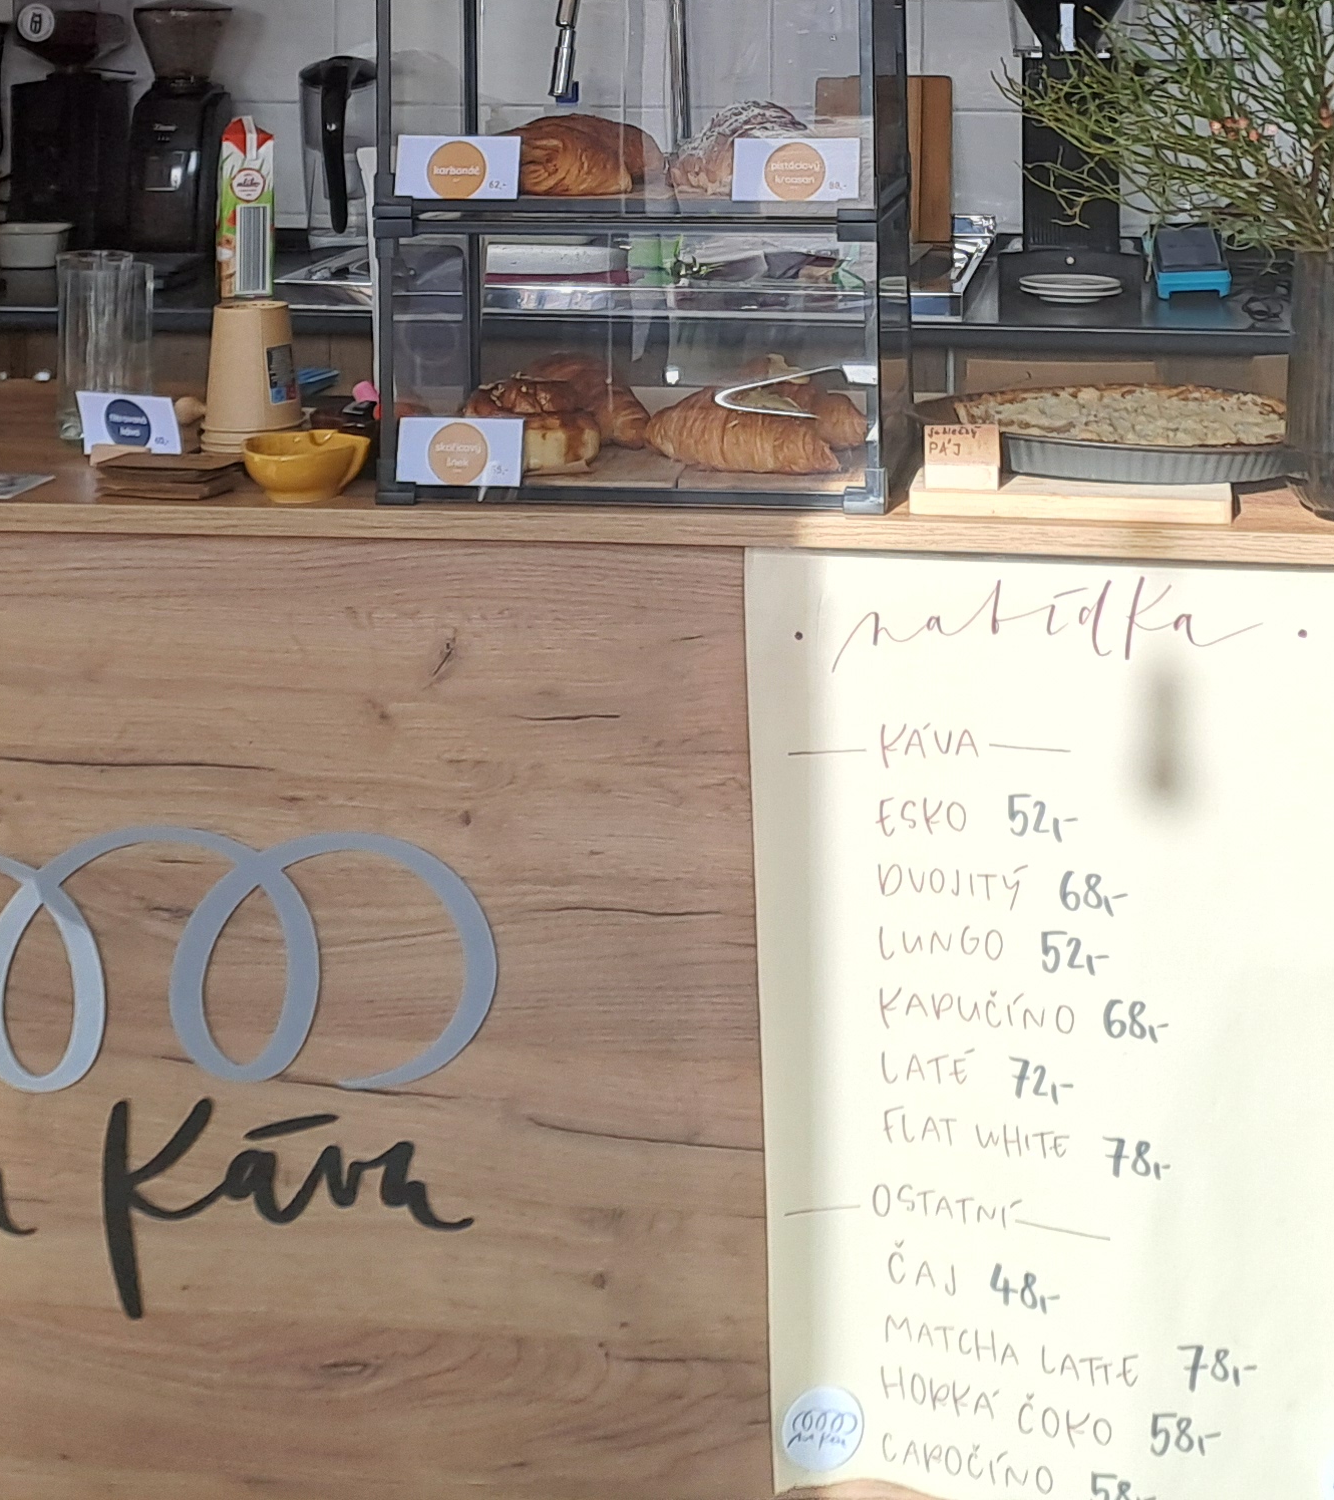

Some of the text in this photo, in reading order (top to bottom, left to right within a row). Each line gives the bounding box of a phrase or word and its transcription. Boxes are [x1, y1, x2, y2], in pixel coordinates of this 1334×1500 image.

[774, 175, 815, 185] kroasan
[928, 437, 962, 457] PÁJ
[831, 576, 1264, 674] nabídka
[880, 722, 980, 769] KÁVA
[875, 793, 1079, 843] ESKO 52,-
[877, 863, 1129, 918] DVOJITÝ 68,-
[878, 925, 1110, 977] LUNGO 52,-
[878, 986, 1170, 1044] KAPUČÍNO 68,-
[880, 1047, 1075, 1106] LATÉ 72,-
[882, 1105, 1171, 1180] FLAT WHITE 78,-
[872, 1183, 1023, 1230] OSTATNÍ
[887, 1239, 1061, 1314] ČAJ 48,-
[883, 1314, 1259, 1393] MATCHA LATTE 78,-
[879, 1364, 1222, 1457] HORKÁ ČOKO 58,-
